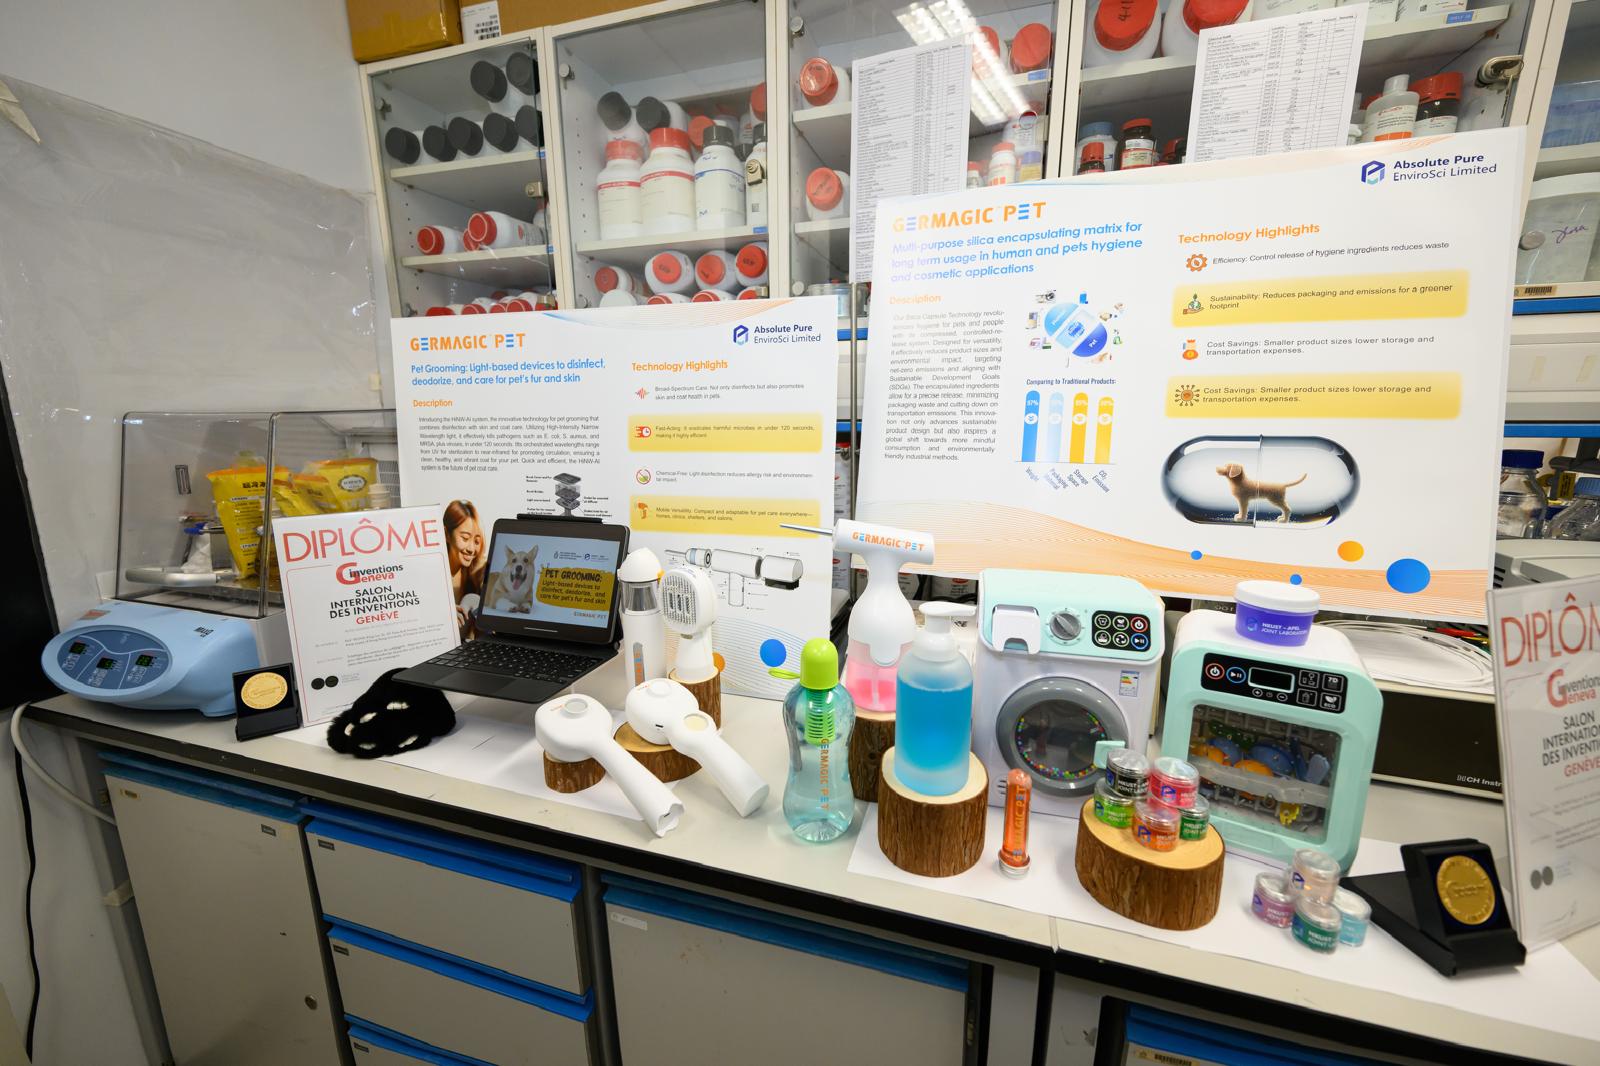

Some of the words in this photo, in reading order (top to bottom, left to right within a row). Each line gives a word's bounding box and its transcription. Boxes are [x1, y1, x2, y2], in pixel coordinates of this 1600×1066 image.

[1394, 156, 1449, 169] Absolute
[1454, 153, 1484, 166] Pure
[1393, 167, 1446, 182] EnviroSci
[1451, 163, 1497, 178] Limited
[892, 206, 994, 232] GERMAGIC
[1004, 202, 1046, 221] PET
[893, 236, 963, 254] Multi-purpose
[967, 234, 994, 246] silica
[997, 226, 1080, 246] encapsulating
[1084, 223, 1122, 236] matrix
[1126, 221, 1142, 233] for
[1178, 228, 1251, 244] Technology
[1255, 224, 1320, 241] Highlights
[891, 256, 913, 271] long
[918, 254, 940, 266] term
[944, 254, 976, 267] usage
[980, 250, 989, 262] in
[992, 247, 1032, 261] human
[1036, 245, 1059, 257] and
[1062, 242, 1088, 258] pets
[1091, 238, 1142, 255] hygiene
[1213, 255, 1247, 267] Efficiency:
[1250, 253, 1276, 263] Control
[1278, 251, 1304, 261] release
[1307, 250, 1314, 259] of
[1316, 248, 1345, 260] hygiene
[1347, 245, 1389, 258] ingredients
[1391, 243, 1423, 253] reduces
[1426, 241, 1449, 251] waste
[891, 270, 911, 281] and
[914, 267, 962, 279] cosmetic
[965, 262, 1034, 279] applications
[890, 294, 941, 304] Description
[1210, 292, 1260, 304] Sustainability:
[1263, 291, 1296, 300] Reduces
[1298, 289, 1337, 300] packaging
[1340, 288, 1354, 296] and
[1356, 286, 1396, 296] emissions
[1399, 286, 1410, 294] for
[1420, 286, 1453, 295] greener
[1210, 302, 1239, 310] footprint
[754, 324, 790, 333] Absolute
[794, 324, 812, 332] Pure
[410, 334, 487, 351] GERMAGIC
[495, 333, 526, 348] PET
[754, 335, 789, 343] EnviroSci
[792, 334, 821, 343] Limited
[1228, 339, 1260, 349] Savings:
[1264, 338, 1294, 346] Smaller
[1297, 338, 1328, 348] product
[1355, 336, 1378, 344] lower
[1382, 335, 1414, 346] storage
[1418, 335, 1435, 343] and
[1207, 348, 1260, 357] transportation
[1264, 348, 1305, 356] expenses.
[412, 364, 423, 372] Pet
[425, 362, 468, 374] Grooming:
[470, 360, 518, 373] Light-based
[520, 359, 554, 369] devices
[557, 359, 565, 368] to
[567, 357, 606, 370] disinfect,
[632, 361, 683, 372] Technology
[686, 359, 728, 371] Highlights
[412, 376, 454, 386] deodorize,
[456, 375, 472, 383] and
[509, 374, 528, 384] pet's
[544, 374, 561, 382] and
[564, 373, 580, 381] skin
[1224, 387, 1256, 395] Savings:
[1294, 386, 1325, 395] product
[1379, 386, 1411, 394] storage
[413, 399, 452, 408] Description
[283, 518, 440, 562] DIPLÔME
[852, 532, 904, 548] GERMAGIC
[905, 540, 924, 551] PET
[336, 562, 394, 585] Geneva
[350, 564, 404, 578] inventions
[545, 569, 558, 578] PET
[561, 571, 602, 582] GROOMING:
[331, 591, 417, 608] INTERNATIONAL
[355, 586, 392, 597] SALON
[330, 607, 350, 619] DES
[353, 597, 420, 615] INVENTIONS
[356, 611, 399, 624] GENÈVE
[1547, 669, 1596, 708] Geneva
[1558, 674, 1600, 695] invention
[1563, 710, 1595, 730] SALON
[820, 738, 829, 785] GERMAGIC
[1542, 751, 1560, 767] DES
[1481, 779, 1502, 787] Instr
[820, 788, 829, 811] PET
